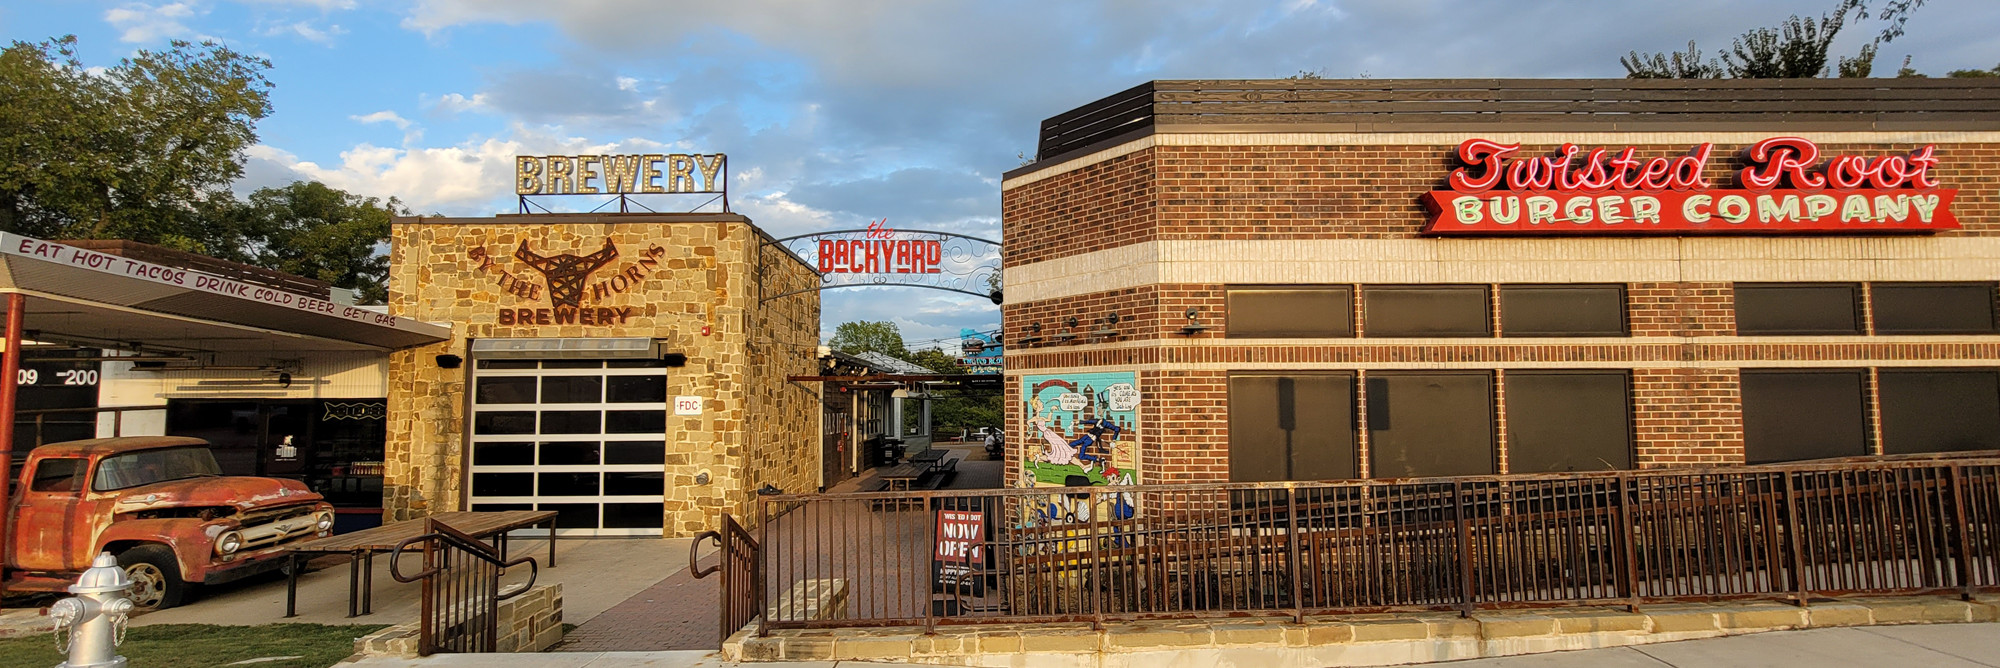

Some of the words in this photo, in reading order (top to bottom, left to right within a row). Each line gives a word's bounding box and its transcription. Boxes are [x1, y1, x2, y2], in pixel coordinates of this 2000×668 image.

[515, 153, 726, 195] BREWERY
[1449, 138, 1713, 193] Twisted
[1740, 136, 1941, 193] Root
[1452, 195, 1662, 225] BURGER
[1682, 194, 1940, 224] COMPANY
[866, 218, 896, 240] the
[467, 245, 496, 273] BY
[496, 269, 544, 302] THE
[591, 242, 666, 302] HORNS
[818, 239, 942, 274] BACKYARD
[18, 239, 65, 259] EAT
[71, 249, 117, 270] HOT
[125, 259, 187, 286] TACOS
[195, 275, 250, 297] DRINK
[254, 287, 293, 305] COLD
[297, 296, 335, 314] BEER
[342, 306, 370, 321] GET
[374, 313, 397, 327] GAS
[499, 307, 632, 326] BREWERY
[679, 400, 698, 411] FDC
[944, 522, 979, 540] NOW
